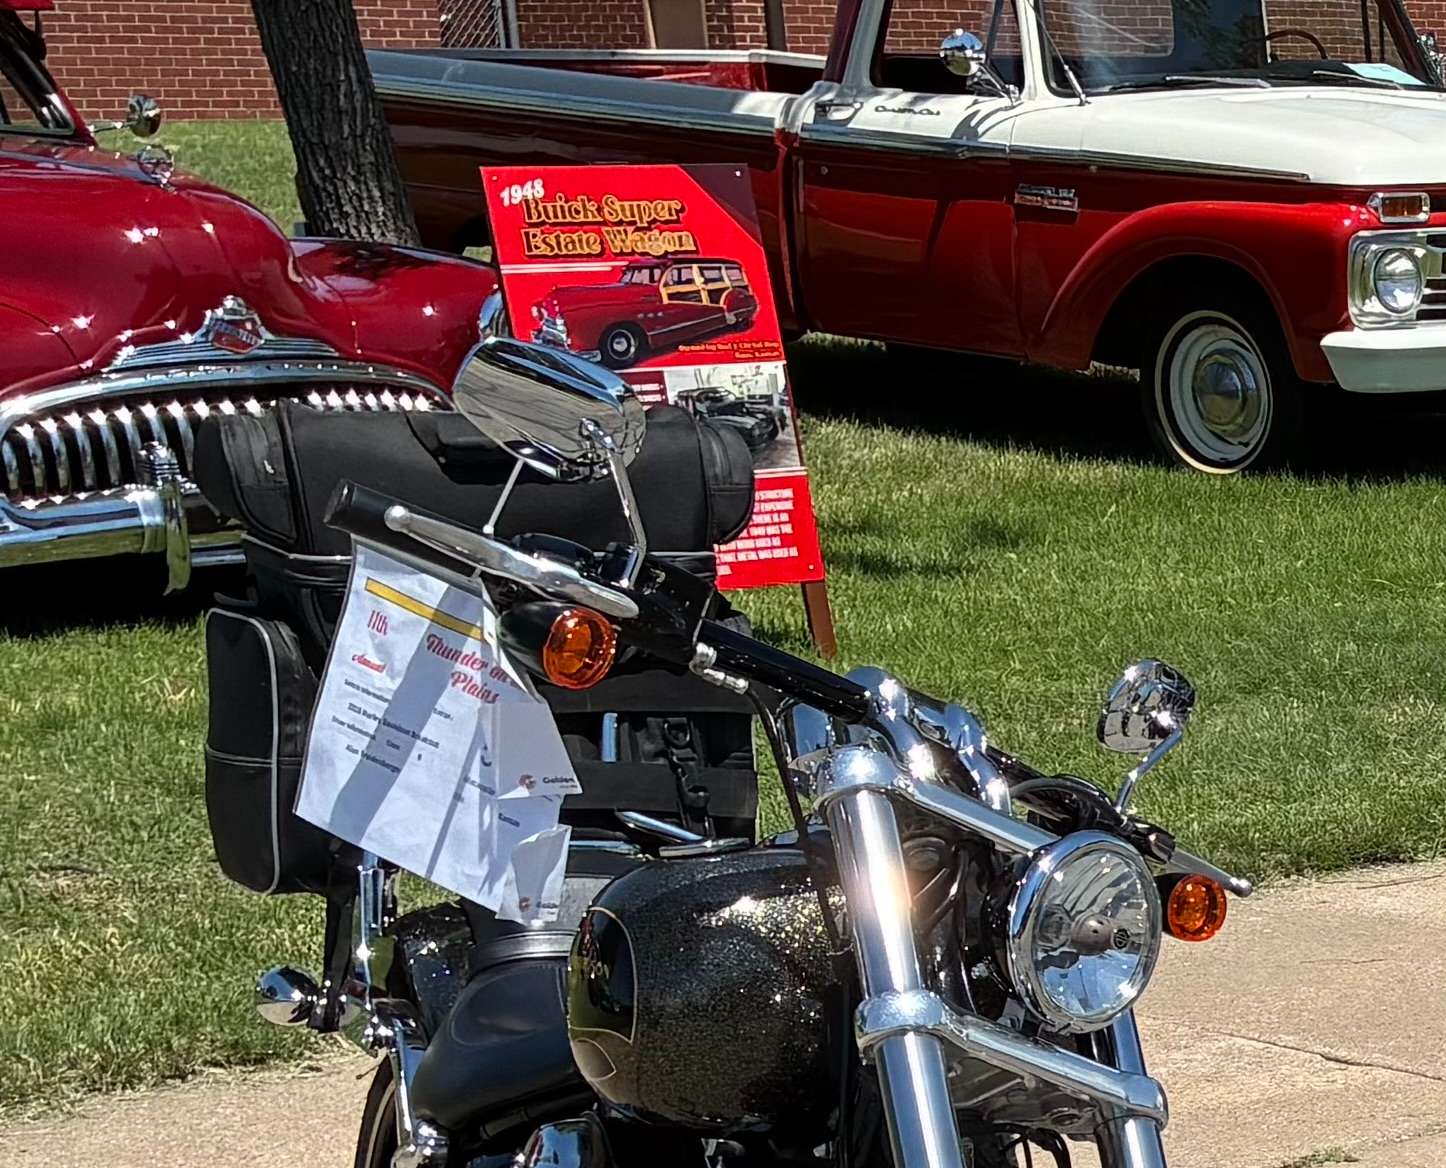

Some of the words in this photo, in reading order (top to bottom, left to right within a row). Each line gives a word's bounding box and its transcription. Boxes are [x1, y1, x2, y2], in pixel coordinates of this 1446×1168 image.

[500, 179, 545, 207] 1948
[522, 195, 602, 225] Buick
[602, 194, 685, 226] Super
[523, 228, 602, 257] Estate
[604, 227, 697, 257] Wagon
[367, 609, 389, 636] 11th
[426, 633, 489, 671] Thunder
[450, 671, 500, 705] Plains
